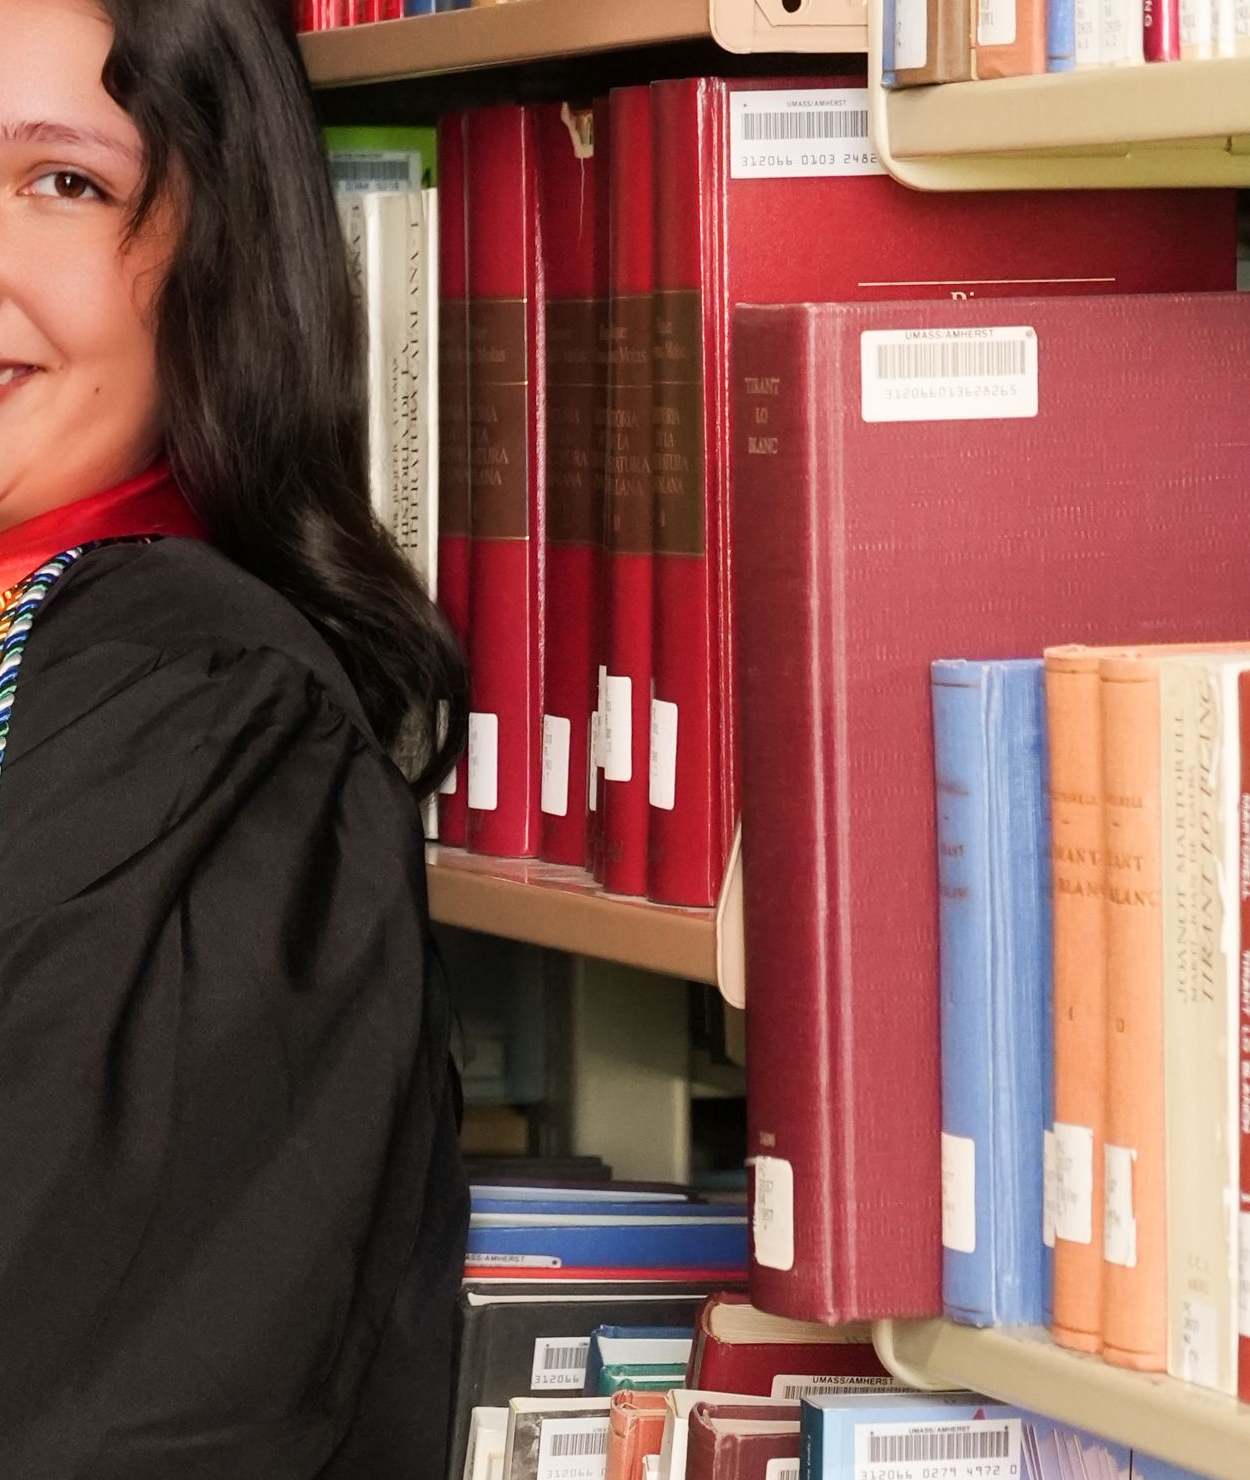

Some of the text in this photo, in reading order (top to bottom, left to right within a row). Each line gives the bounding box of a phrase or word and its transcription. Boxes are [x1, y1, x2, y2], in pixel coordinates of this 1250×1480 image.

[787, 99, 846, 108] UMASS/AMHERST
[741, 153, 877, 167] 312066 0103 2482
[904, 329, 995, 340] UMASS/AMHERST
[745, 377, 781, 395] TIRANT
[408, 251, 419, 550] LITERATURA CATALANA
[755, 407, 768, 424] LO
[534, 1374, 580, 1384] 312066
[812, 1375, 895, 1386] UMASS/AMHERST
[908, 1426, 971, 1435] UMASS/AMHERST
[546, 1468, 593, 1479] 312066
[922, 1466, 958, 1480] 0279
[966, 1465, 1002, 1478] 4972
[1009, 1463, 1018, 1475] 0
